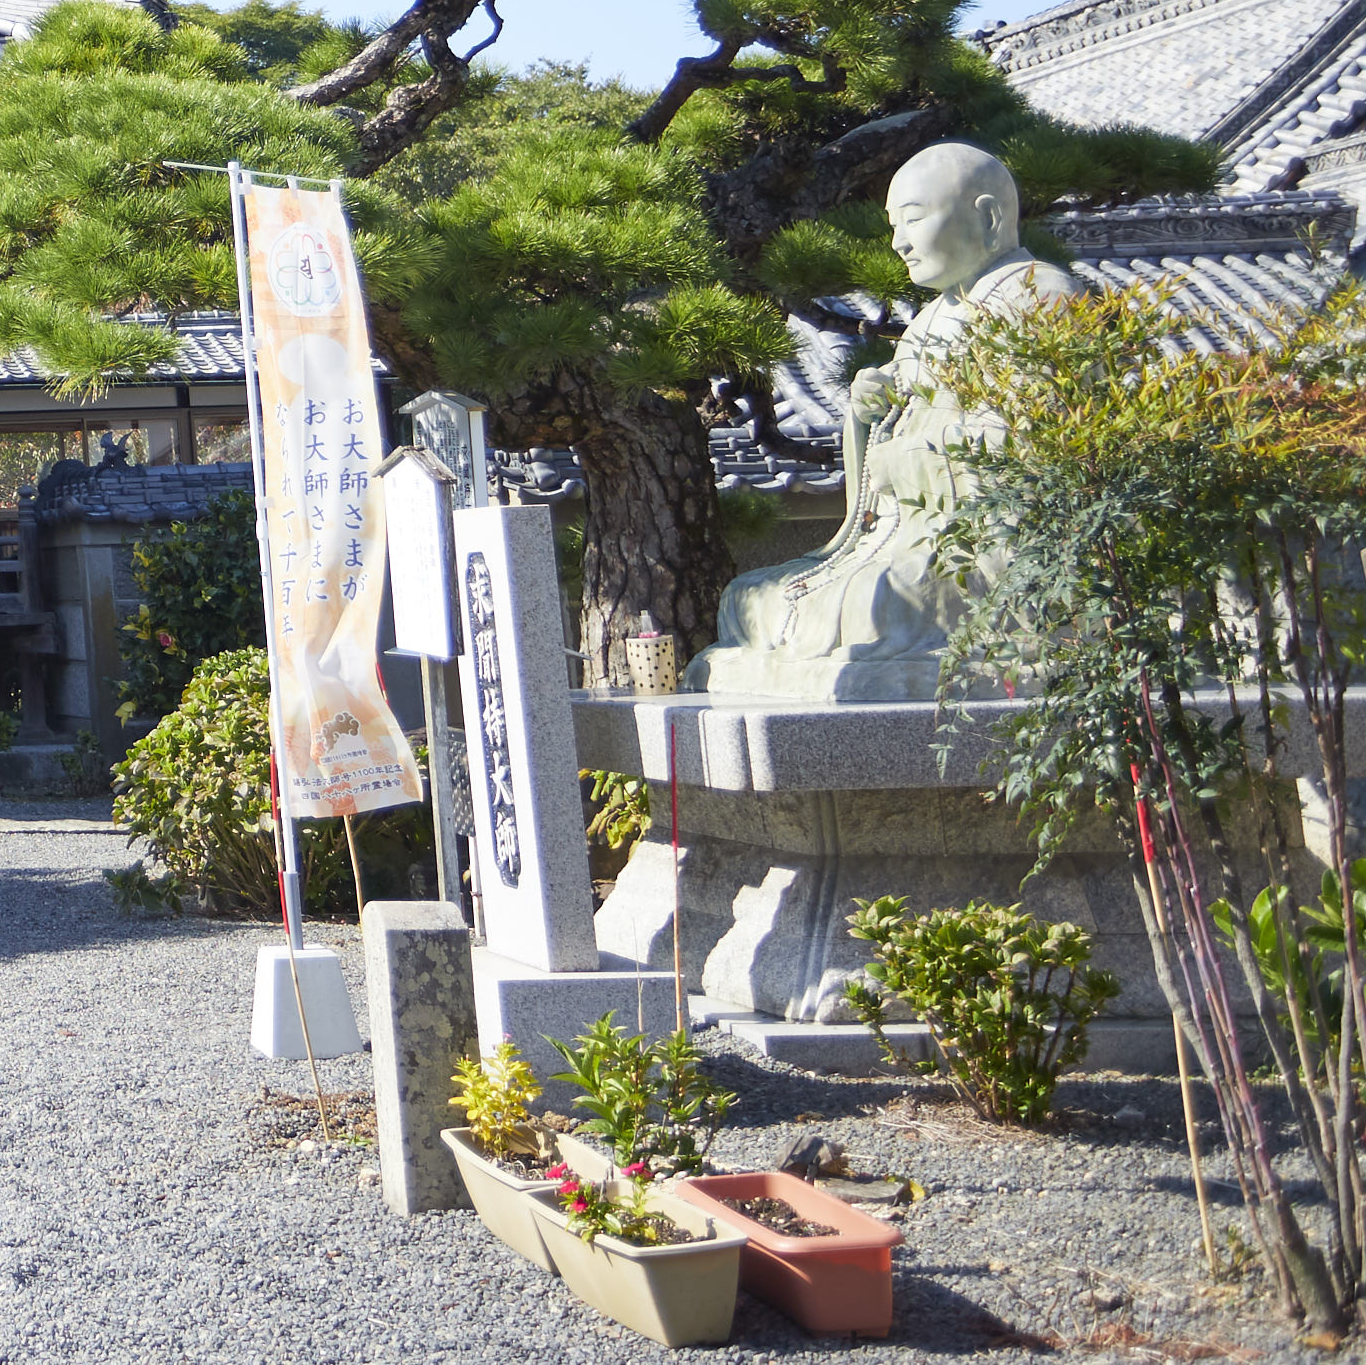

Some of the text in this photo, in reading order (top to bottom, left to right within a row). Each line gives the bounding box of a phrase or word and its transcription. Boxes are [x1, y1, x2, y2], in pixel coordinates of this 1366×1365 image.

[303, 397, 330, 602] お大師さまに
[339, 397, 370, 602] お大師さまが
